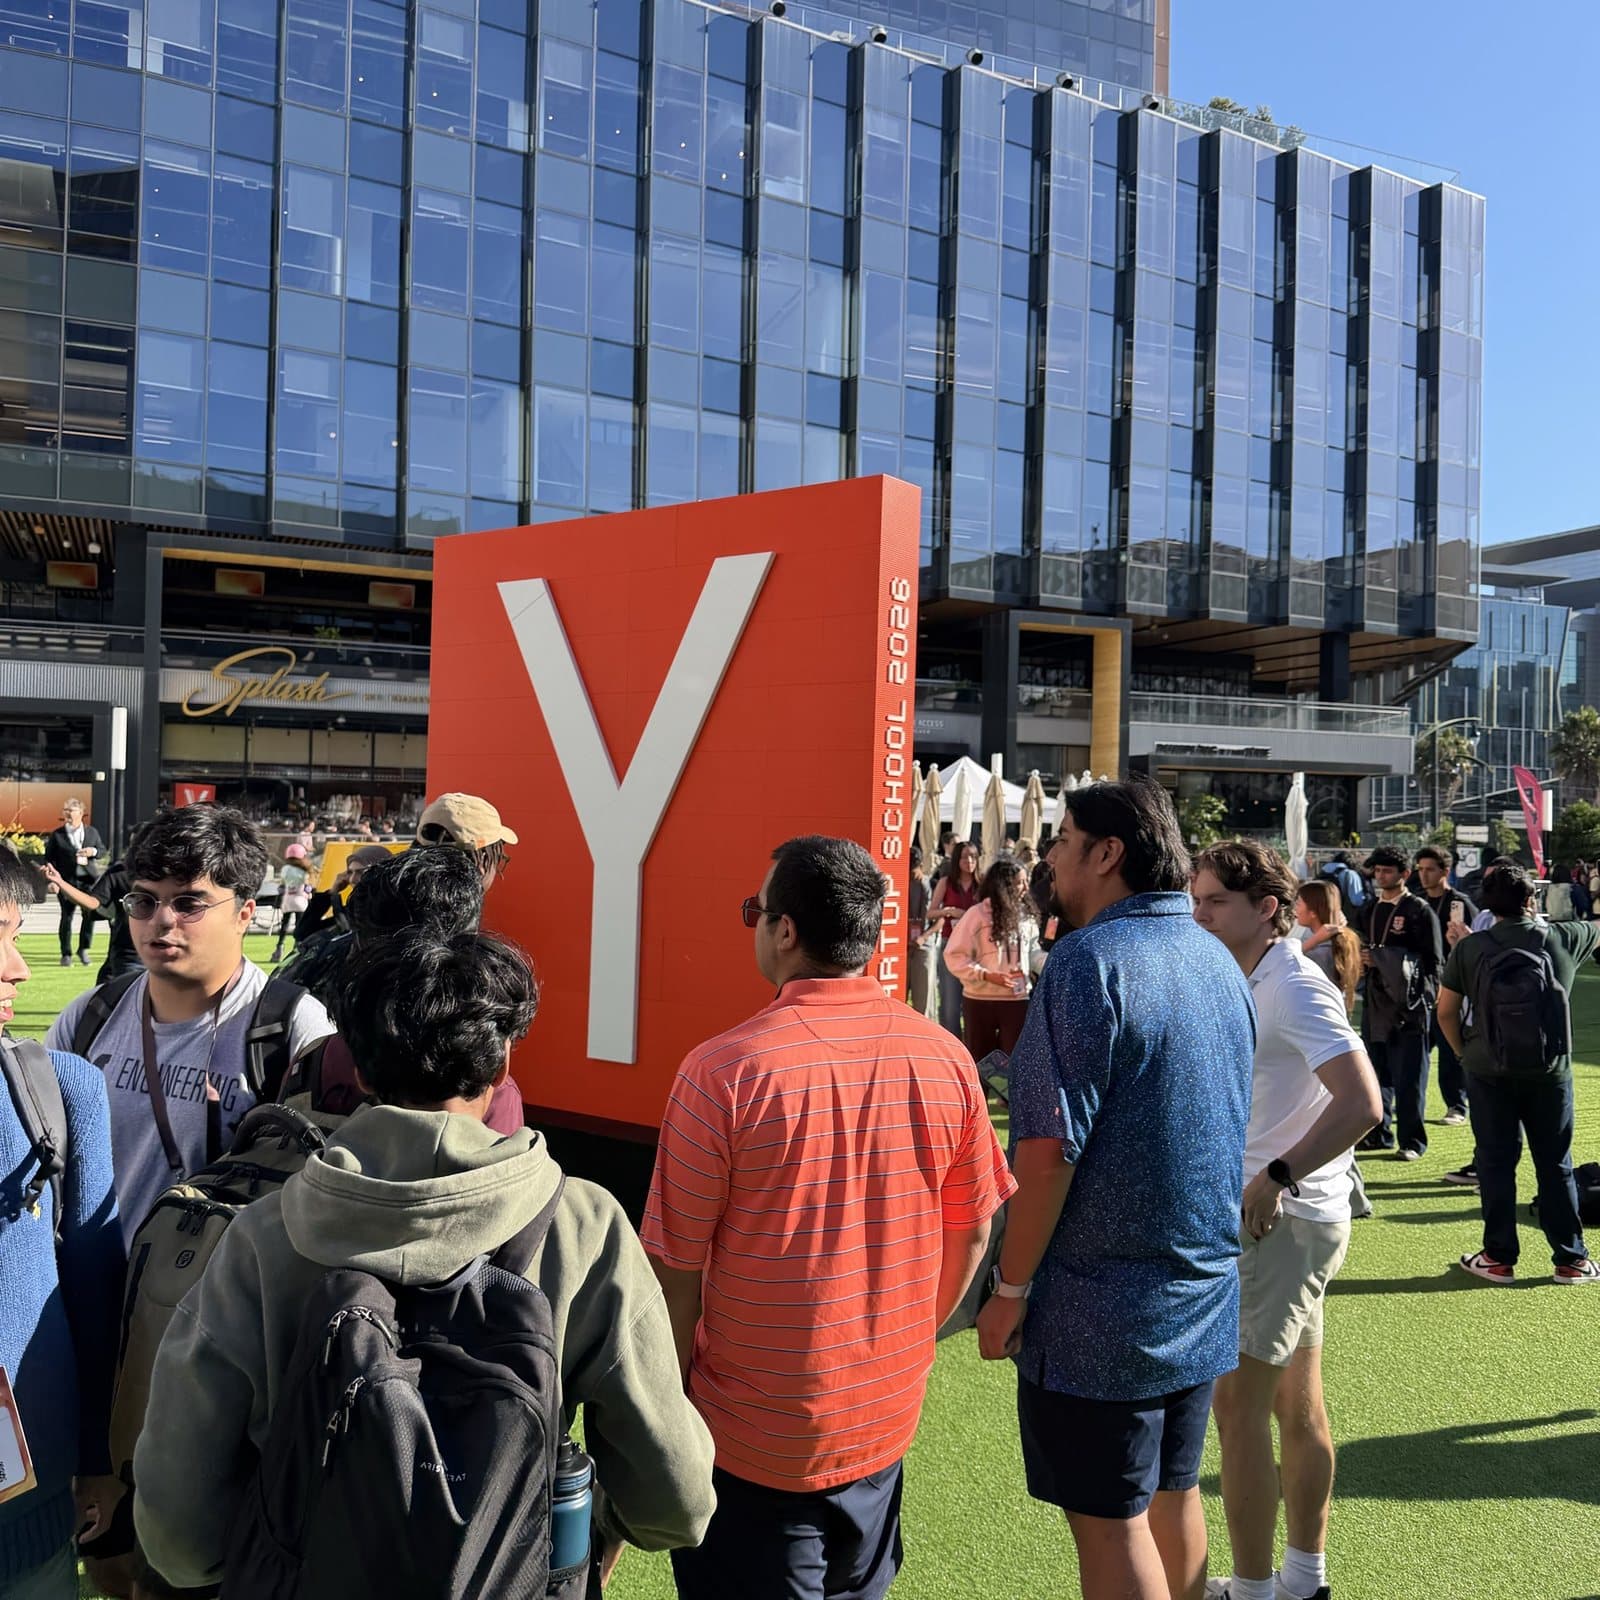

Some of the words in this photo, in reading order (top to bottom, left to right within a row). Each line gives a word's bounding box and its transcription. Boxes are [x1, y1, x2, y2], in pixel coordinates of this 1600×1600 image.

[181, 646, 354, 717] Splash
[888, 575, 911, 685] 2026
[495, 550, 777, 1065] Y
[882, 700, 908, 860] SCHOOL
[880, 873, 901, 998] ARTUP
